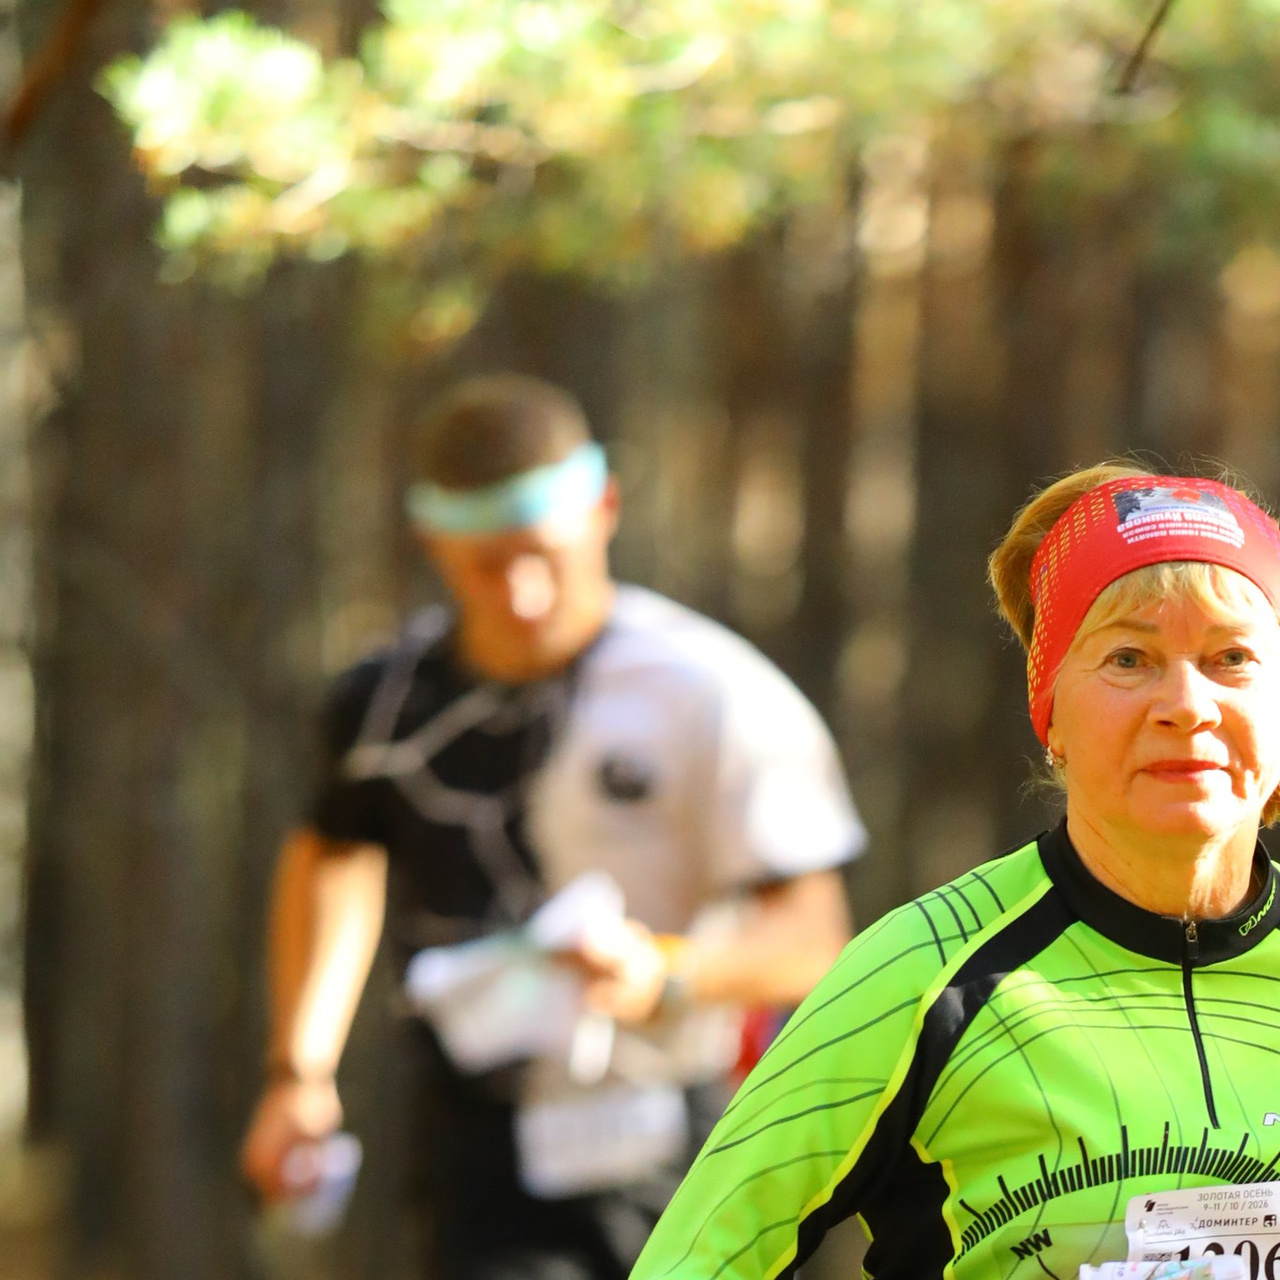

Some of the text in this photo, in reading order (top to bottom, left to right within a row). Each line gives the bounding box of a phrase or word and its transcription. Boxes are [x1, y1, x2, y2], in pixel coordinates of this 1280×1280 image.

[1197, 1188, 1274, 1202] ЗОЛОТАЯ ОСЕНЬ
[1248, 1200, 1269, 1209] 2026
[1198, 1217, 1259, 1229] ДОМИНТЕР
[1010, 1228, 1053, 1260] NW
